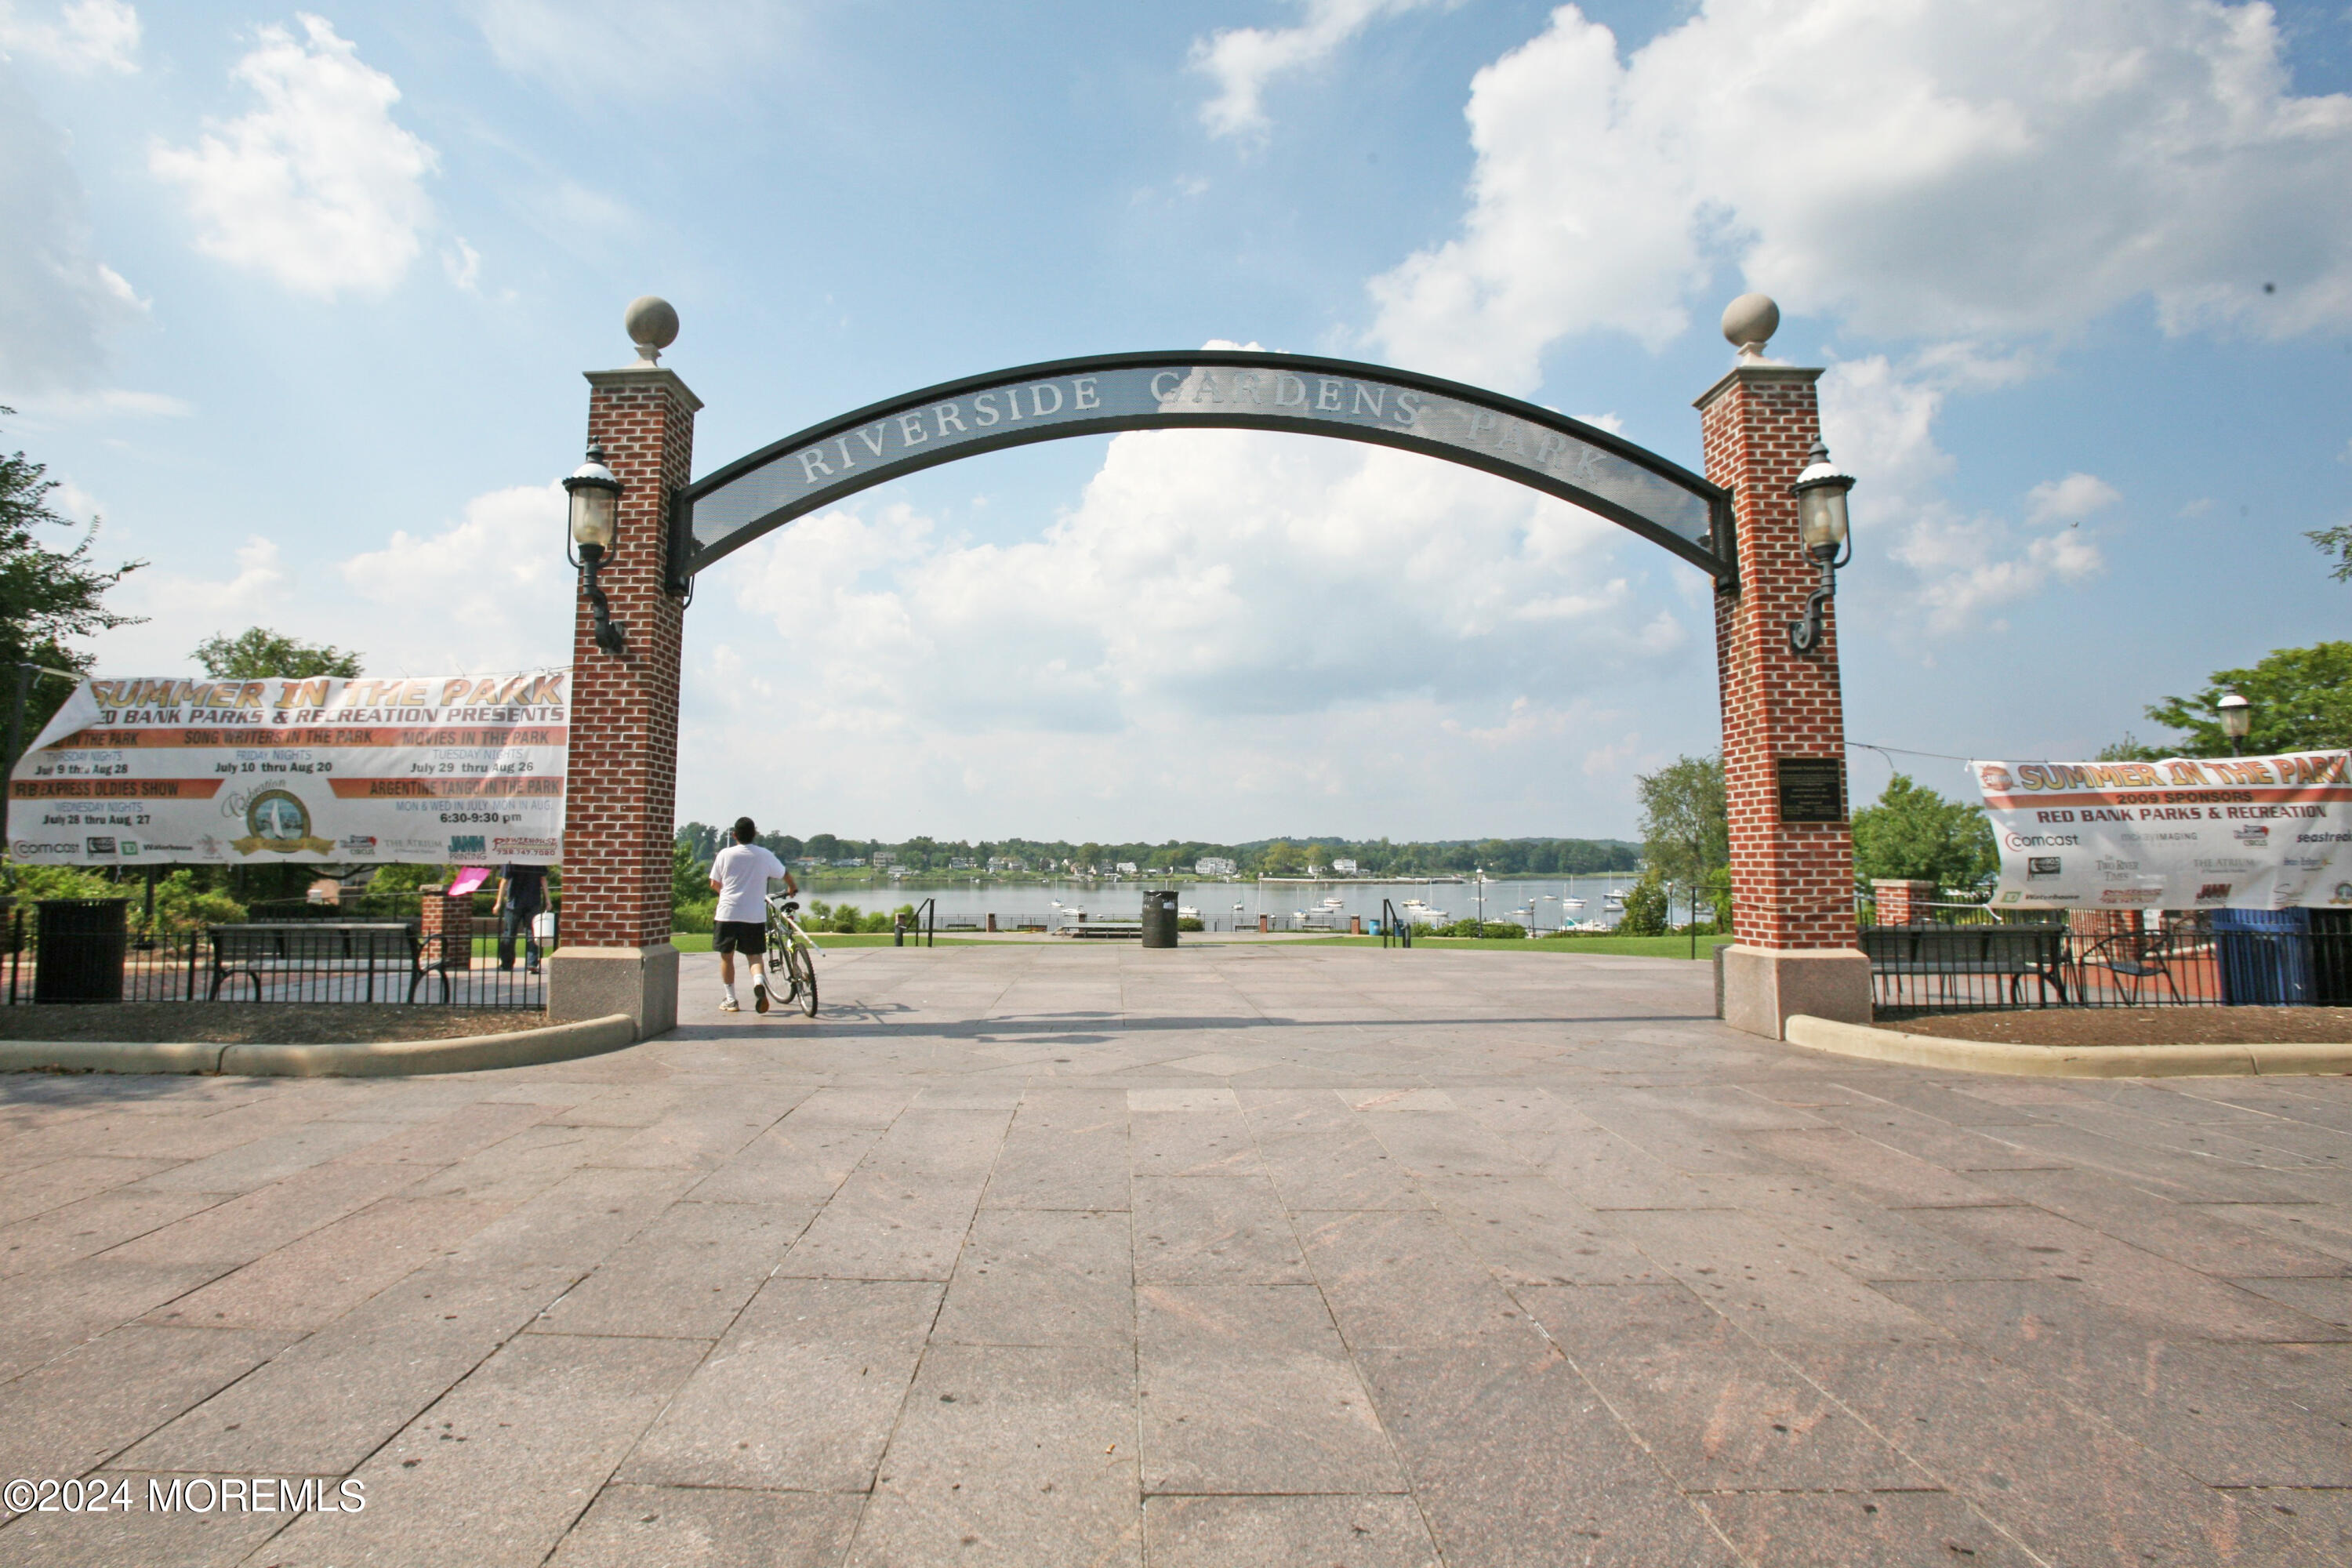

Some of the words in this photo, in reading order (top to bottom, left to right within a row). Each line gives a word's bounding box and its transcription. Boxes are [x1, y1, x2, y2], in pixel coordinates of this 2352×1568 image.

[797, 377, 1101, 484] RIVERSIDE
[1150, 371, 1421, 425] GARDENS
[1465, 409, 1607, 485] PARK
[90, 680, 266, 709] SUMMER
[273, 680, 330, 709] IN
[343, 680, 426, 706] THE
[440, 675, 564, 706] PARK
[95, 710, 117, 724] ED
[124, 710, 181, 724] BANK
[188, 710, 265, 724] PARKS
[271, 710, 288, 724] &
[295, 707, 438, 723] RECREATION
[446, 706, 565, 722] PRESENTS
[85, 732, 107, 746] THE
[108, 732, 140, 746] PARK
[183, 731, 220, 745] SONG
[223, 731, 281, 745] WRITERS
[285, 730, 300, 744] IN
[307, 730, 332, 743] THE
[335, 729, 373, 743] PARK
[401, 731, 456, 746] MOVIES
[461, 730, 476, 745] IN
[481, 730, 509, 744] THE
[513, 730, 550, 744] PARK
[91, 751, 122, 762] NIGHTS
[236, 750, 269, 761] FRIDAY
[273, 750, 312, 760] NIGHTS
[432, 749, 480, 760] TUESDAY
[484, 749, 523, 760] NIGHTS
[68, 764, 90, 774] thu
[93, 764, 113, 775] Aug
[114, 764, 128, 774] 28
[215, 763, 238, 775] July
[241, 763, 256, 773] 10
[261, 762, 286, 772] thru
[289, 762, 314, 774] Aug
[317, 762, 332, 772] 20
[410, 762, 435, 775] July
[438, 763, 455, 772] 29
[462, 763, 488, 772] thru
[491, 762, 514, 773] Aug
[517, 762, 534, 771] 26
[2018, 765, 2167, 791] SUMMER
[2163, 761, 2211, 785] IN
[2201, 760, 2274, 785] THE
[2270, 756, 2351, 784] PARK
[15, 782, 38, 797] RB
[40, 782, 91, 796] EXPRESS
[94, 782, 136, 796] OLDIES
[141, 782, 179, 796] SHOW
[369, 780, 436, 795] ARGENTINE
[441, 780, 480, 794] TANGO
[484, 780, 497, 793] IN
[500, 779, 524, 793] THE
[527, 779, 560, 793] PARK
[2117, 793, 2160, 804] 2009
[2164, 791, 2254, 803] SPONSORS
[54, 801, 104, 813] WEDNESDAY
[107, 801, 144, 813] NIGHTS
[396, 800, 419, 811] MON
[421, 800, 428, 811] &
[430, 800, 452, 811] WED
[454, 800, 464, 811] IN
[466, 800, 488, 811] JULY
[492, 800, 515, 810] MON
[518, 800, 528, 810] IN
[440, 812, 499, 823] 6:30-9:30
[503, 813, 522, 825] pm
[2037, 810, 2074, 823] RED
[2081, 808, 2133, 822] BANK
[2140, 807, 2201, 821] PARKS
[2208, 807, 2222, 819] &
[2227, 804, 2327, 819] RECREATION
[42, 815, 66, 826] July
[85, 815, 106, 824] thru
[109, 815, 132, 826] Aug
[136, 815, 151, 824] 27
[448, 852, 488, 861] PRINTING
